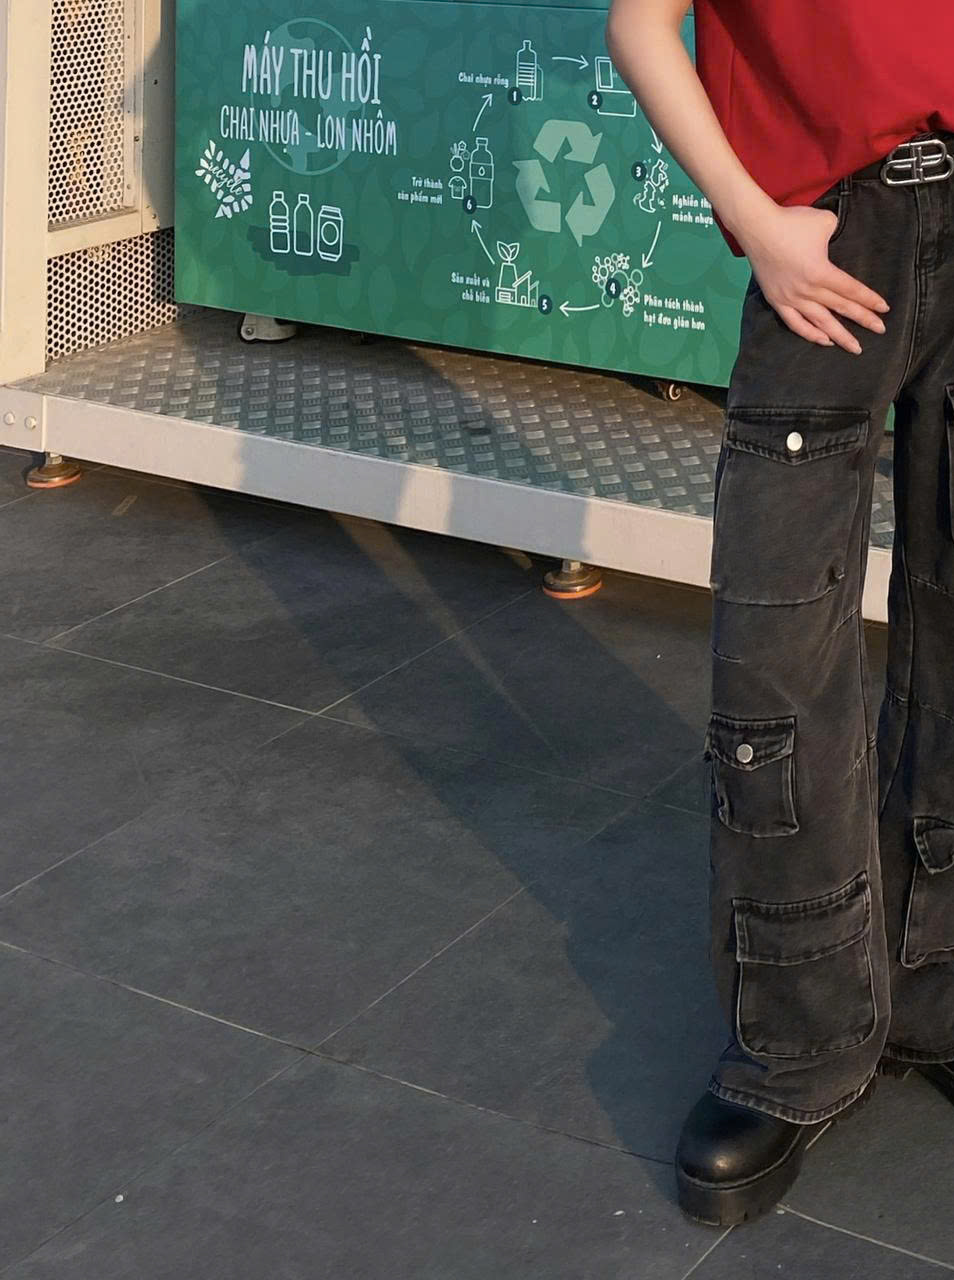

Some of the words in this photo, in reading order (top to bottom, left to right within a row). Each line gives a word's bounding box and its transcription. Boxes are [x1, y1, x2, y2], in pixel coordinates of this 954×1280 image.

[241, 30, 284, 96] MÁY
[290, 48, 334, 100] THU
[341, 26, 382, 105] HỒI
[458, 72, 474, 83] Chai
[591, 94, 599, 105] 2
[219, 105, 255, 141] CHAI
[259, 106, 300, 154] NHỰA
[316, 113, 346, 151] LON
[351, 109, 397, 156] NHÔM
[635, 166, 642, 178] 3
[208, 161, 244, 196] recycle
[466, 199, 473, 210] 6
[609, 282, 617, 294] 4
[540, 298, 548, 310] 5
[643, 293, 663, 307] Phân
[664, 297, 681, 310] tách
[682, 299, 705, 313] thành
[643, 309, 656, 327] hạt
